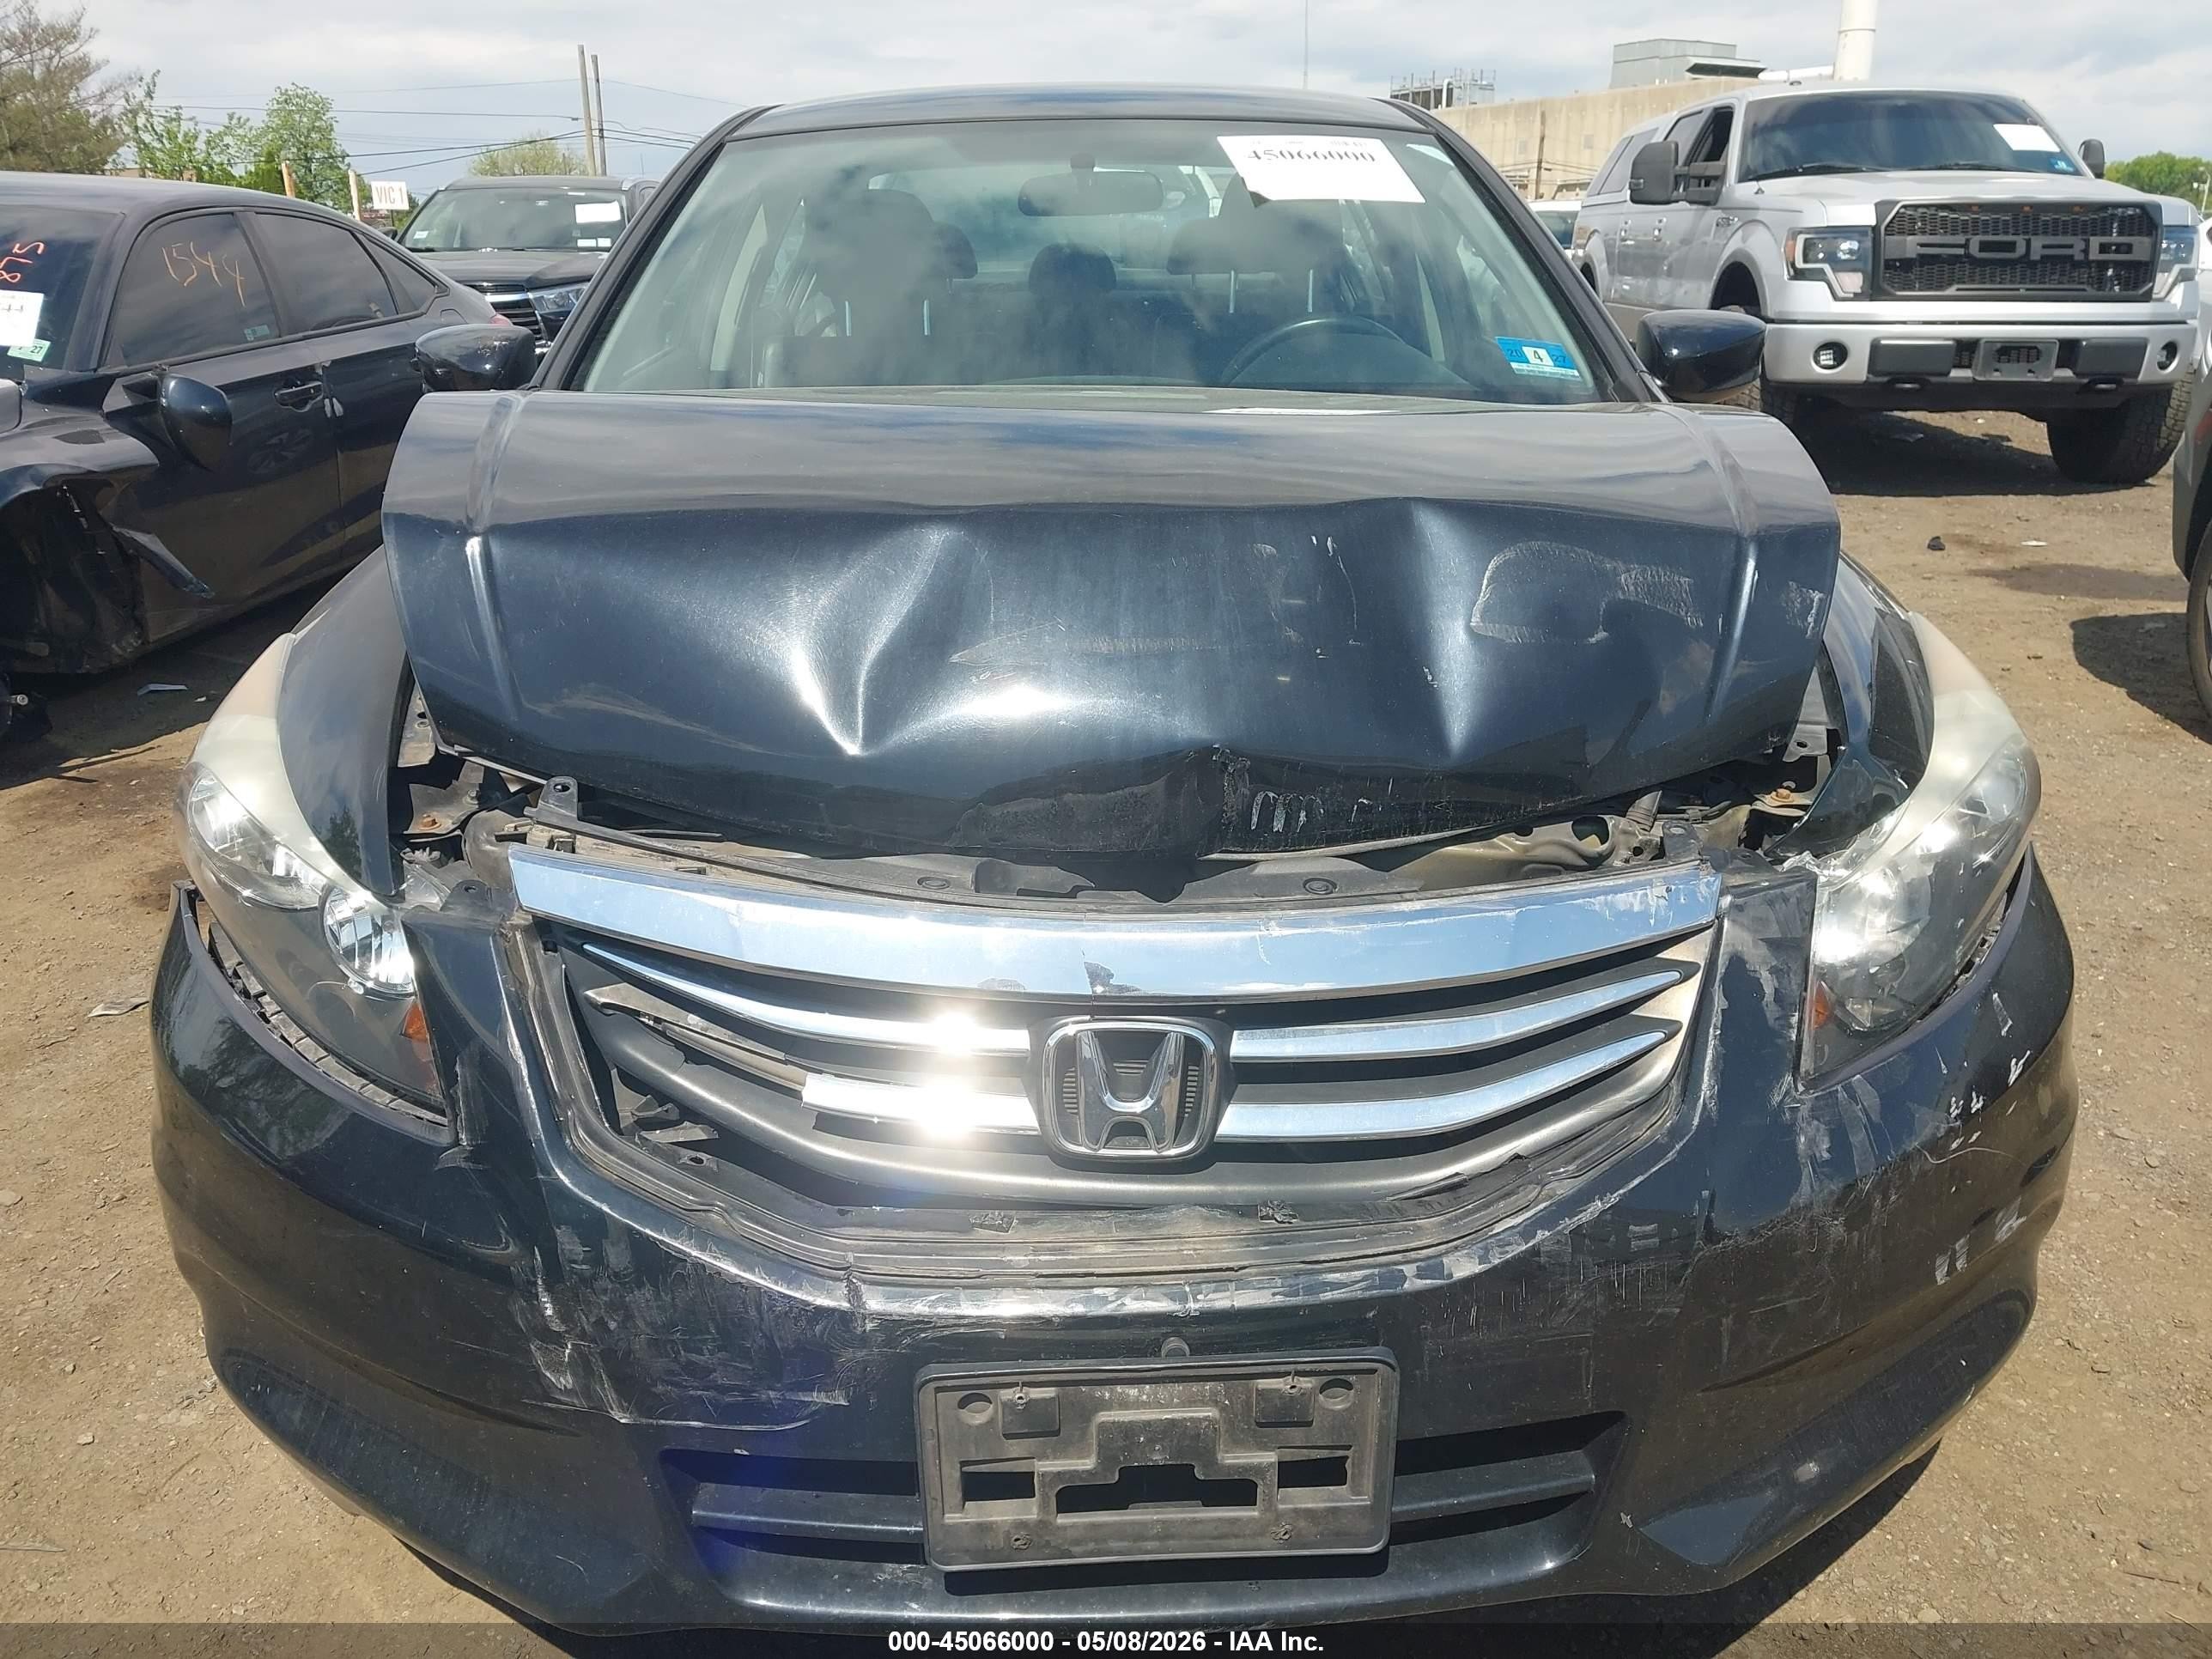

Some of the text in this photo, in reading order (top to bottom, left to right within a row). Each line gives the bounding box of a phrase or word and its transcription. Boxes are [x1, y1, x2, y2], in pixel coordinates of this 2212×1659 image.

[374, 185, 404, 205] VIC 1
[1903, 235, 2149, 260] FORD
[161, 240, 247, 307] 1544
[29, 345, 43, 355] 27
[1506, 349, 1567, 364] 20 4 27
